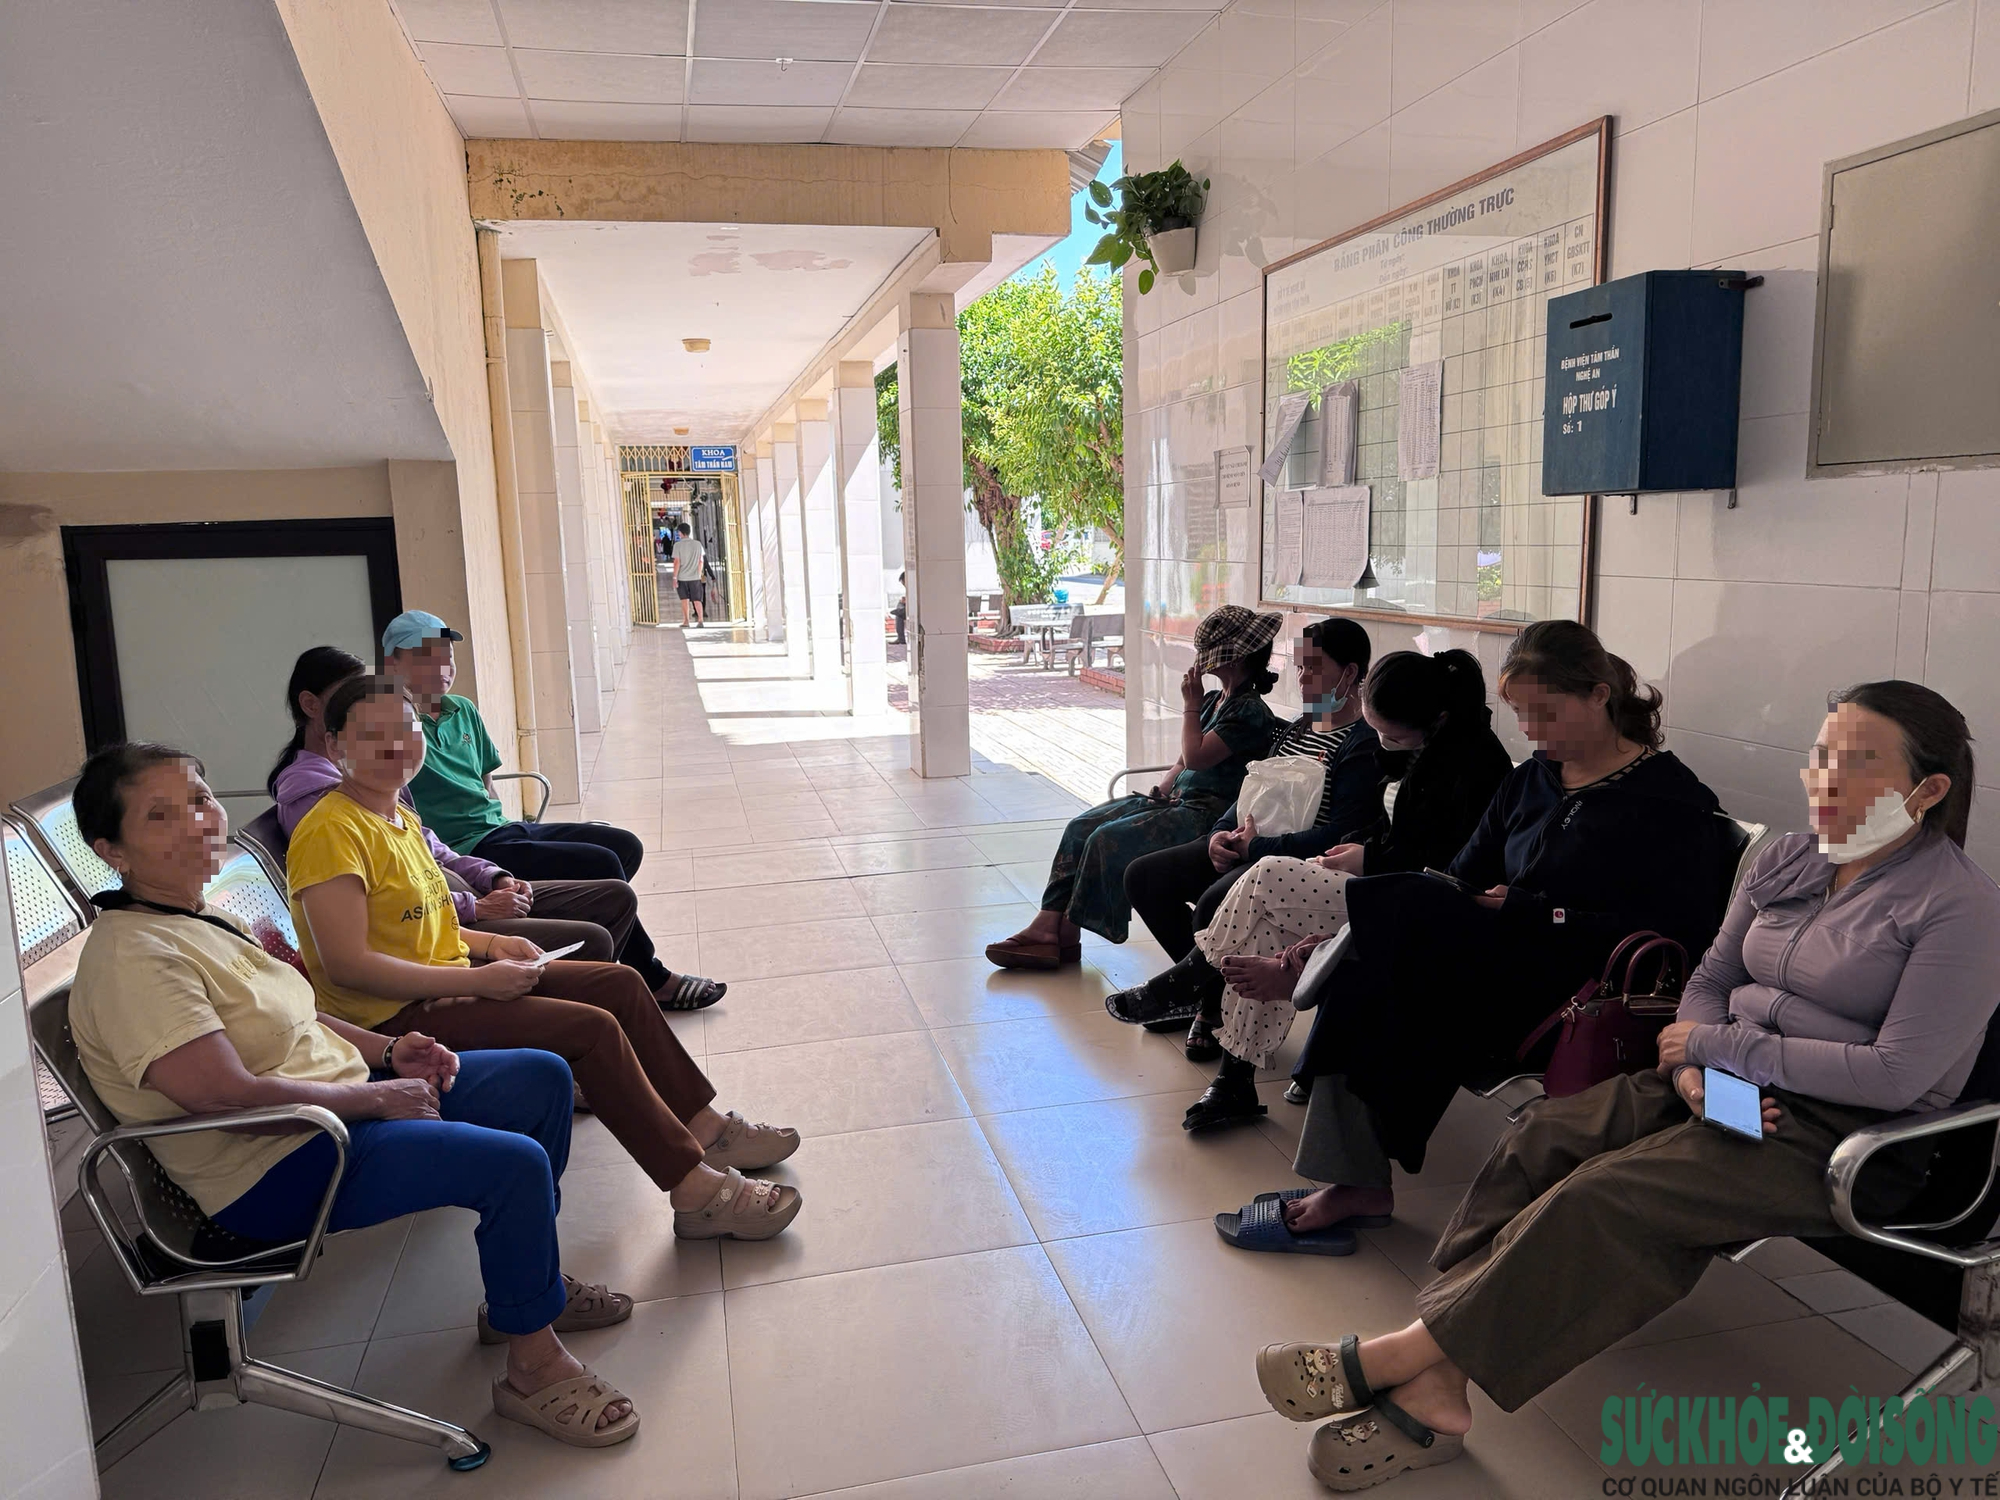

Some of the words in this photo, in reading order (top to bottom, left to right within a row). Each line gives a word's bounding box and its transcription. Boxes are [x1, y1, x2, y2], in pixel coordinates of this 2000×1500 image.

[1362, 237, 1390, 262] PHÂN
[1393, 225, 1424, 248] CÔNG
[1426, 204, 1476, 236] THƯỜNG
[1478, 187, 1515, 216] TRỰC
[1492, 252, 1508, 266] KHOA
[1490, 270, 1500, 283] NHI
[1502, 267, 1510, 280] LN
[1572, 262, 1584, 278] (K7)
[1492, 284, 1505, 298] (K4)
[1560, 355, 1576, 370] BỆNH
[1576, 353, 1590, 368] VIỆN
[1590, 351, 1603, 364] TÂM
[1604, 344, 1620, 360] THẦN
[1576, 368, 1590, 382] NGHỆ
[1592, 368, 1600, 380] AN
[1562, 392, 1578, 415] HỘP
[1579, 388, 1594, 412] THƯ
[1594, 386, 1610, 410] GÓP
[1611, 383, 1618, 408] Ý
[1562, 420, 1574, 434] Số:
[1576, 420, 1582, 432] 1
